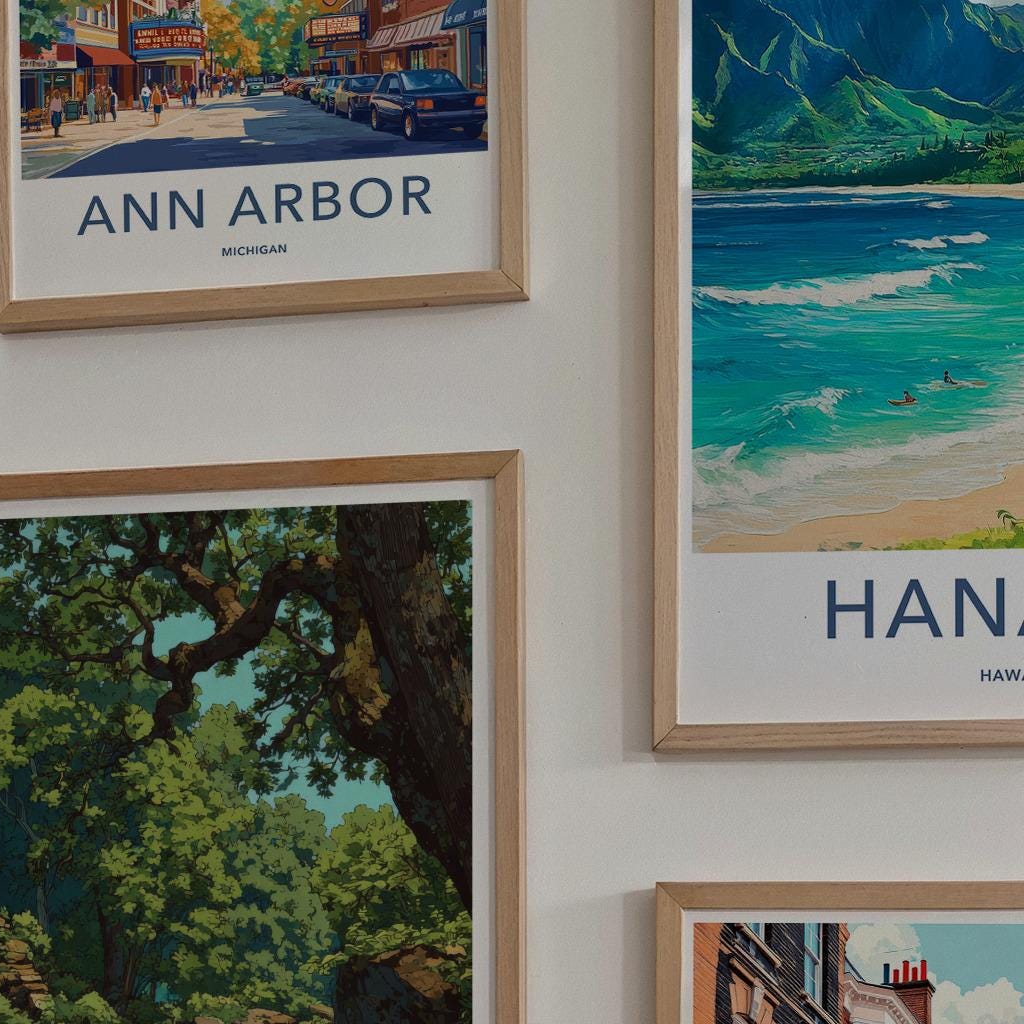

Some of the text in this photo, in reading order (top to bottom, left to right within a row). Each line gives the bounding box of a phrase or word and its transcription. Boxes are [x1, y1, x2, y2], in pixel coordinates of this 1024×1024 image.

[77, 175, 432, 236] ANN ARBOR
[221, 243, 288, 257] MICHIGAN
[826, 577, 1024, 639] HAN
[980, 668, 1024, 682] HAW
